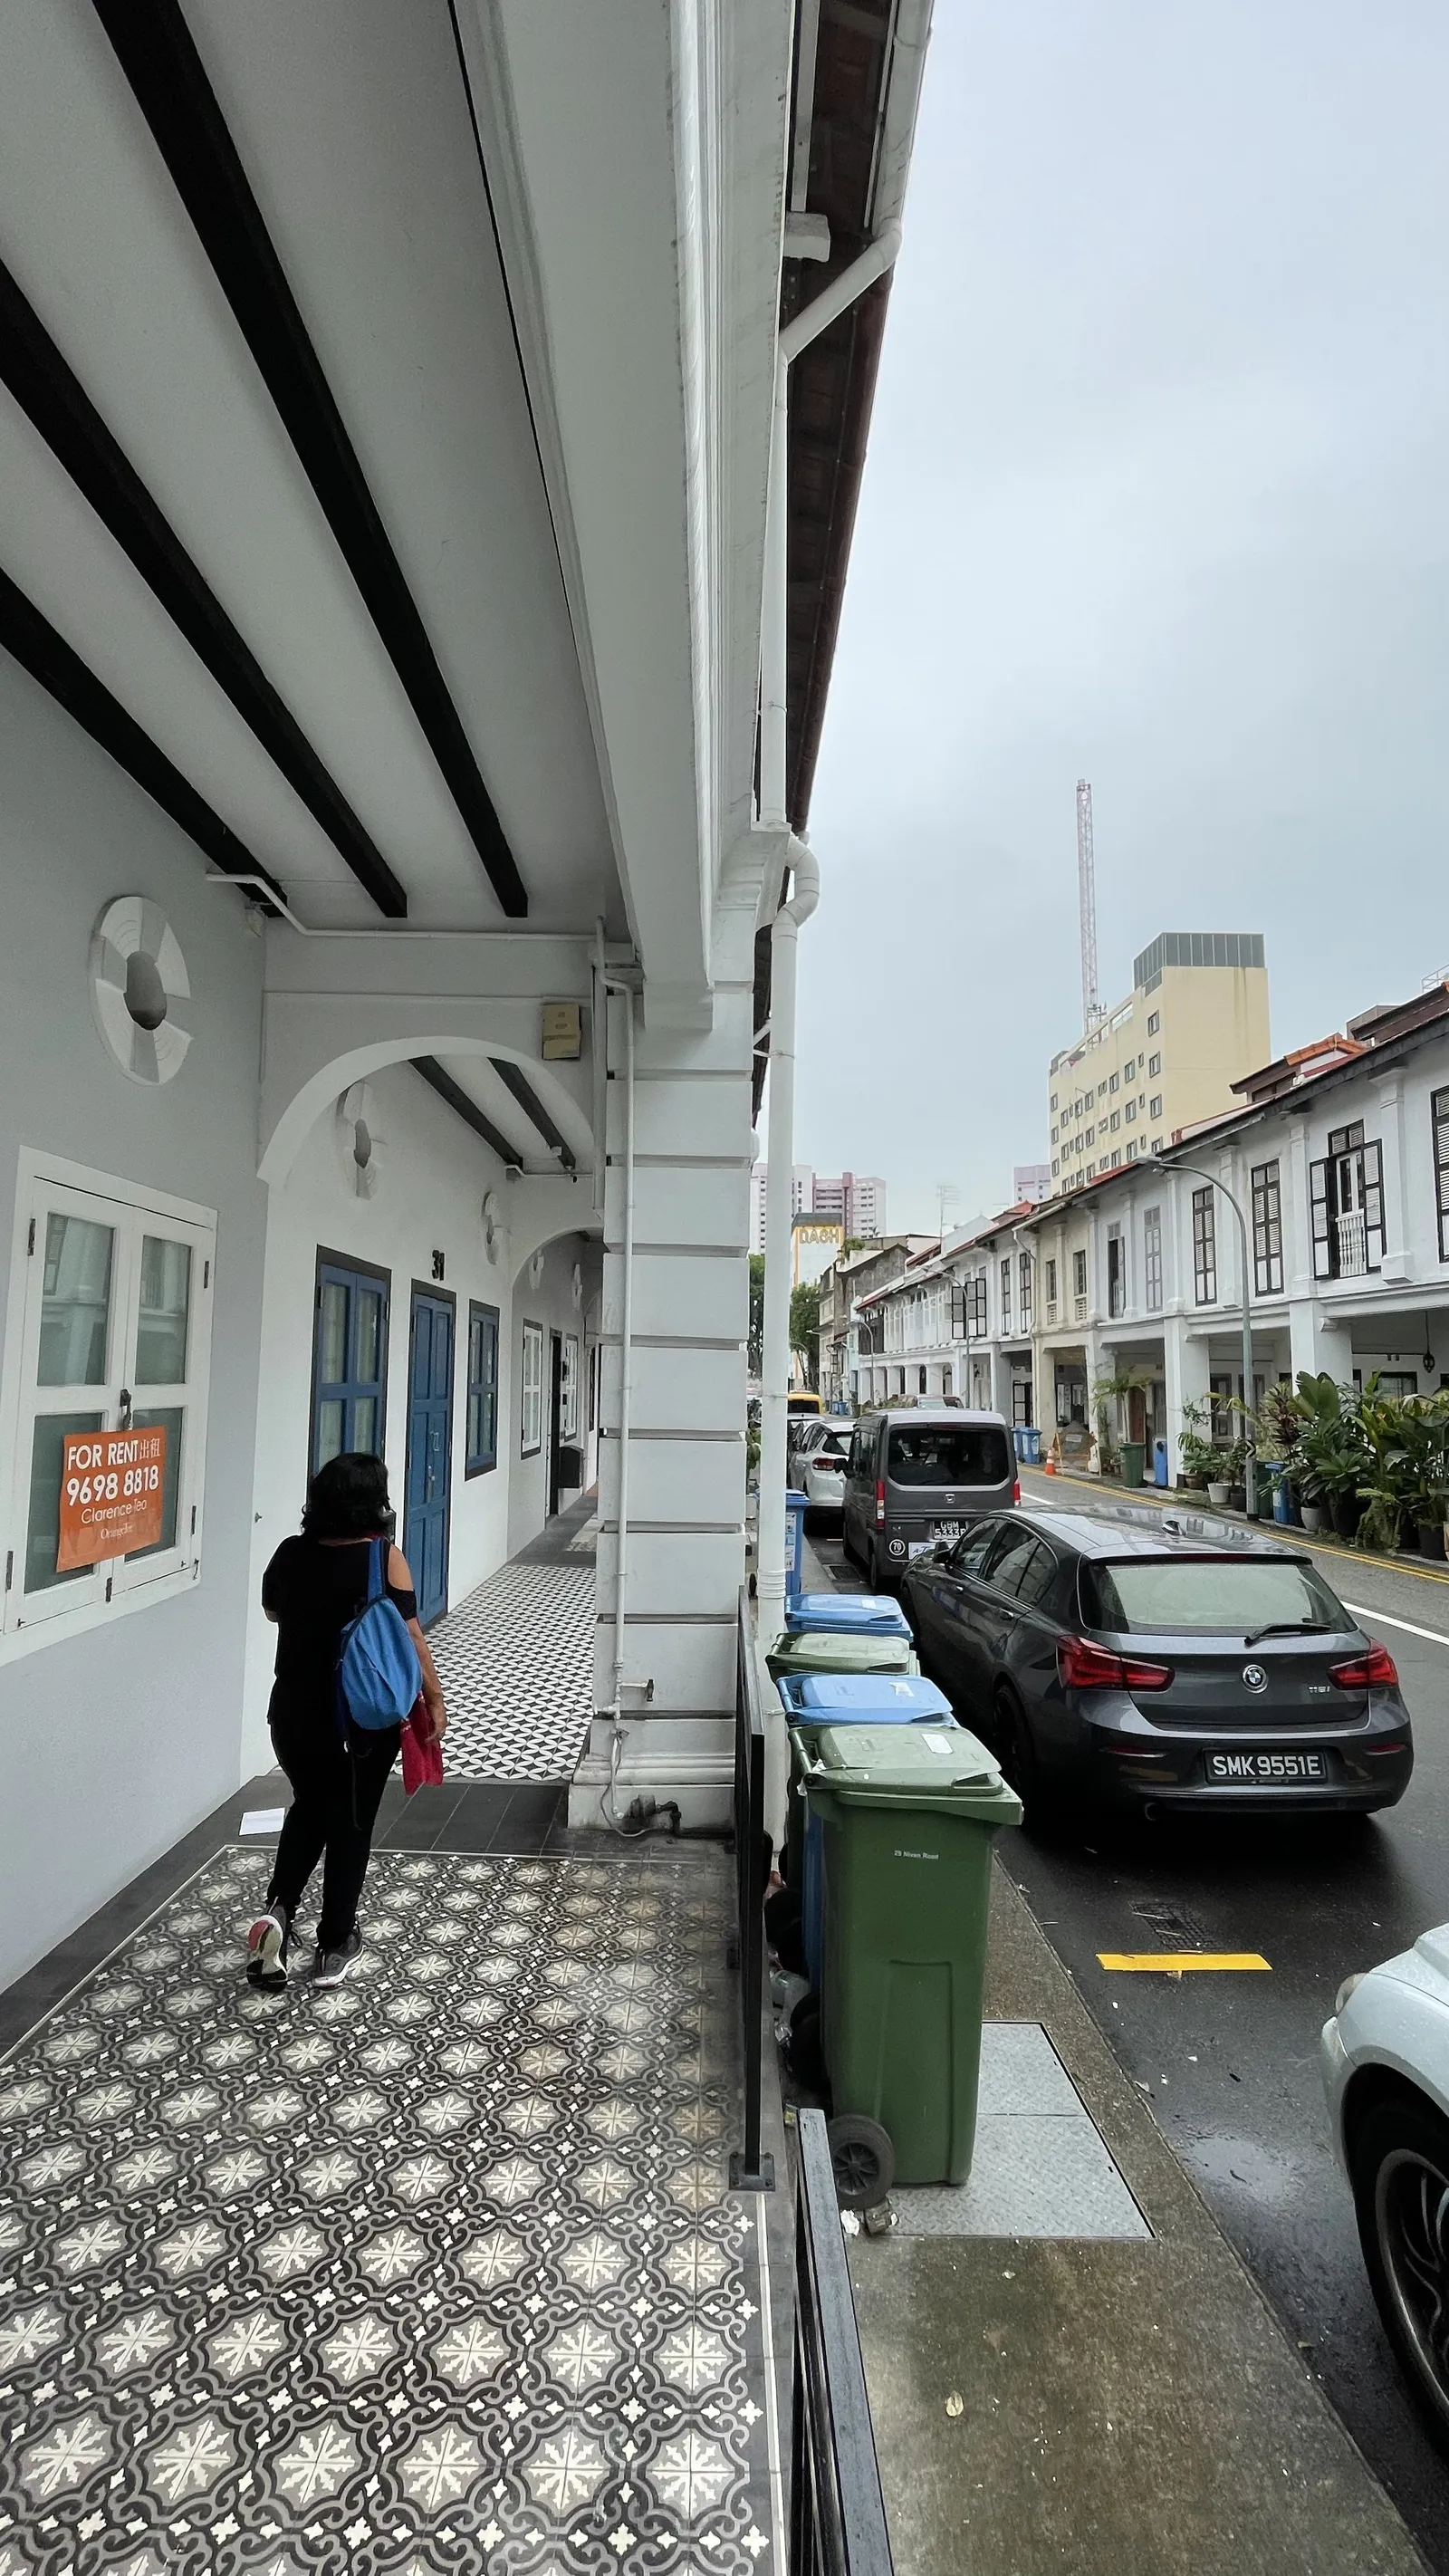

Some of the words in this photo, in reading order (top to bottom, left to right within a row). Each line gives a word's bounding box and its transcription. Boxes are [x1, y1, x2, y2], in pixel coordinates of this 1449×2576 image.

[431, 1249, 446, 1281] 31
[67, 1444, 102, 1471] FOR
[107, 1439, 139, 1466] RENT
[139, 1437, 160, 1460] 出租
[67, 1472, 119, 1507] 9698
[123, 1465, 159, 1496] 8818
[893, 1543, 902, 1551] 70
[1213, 1755, 1256, 1776] SMK
[1256, 1755, 1321, 1775] 9551E
